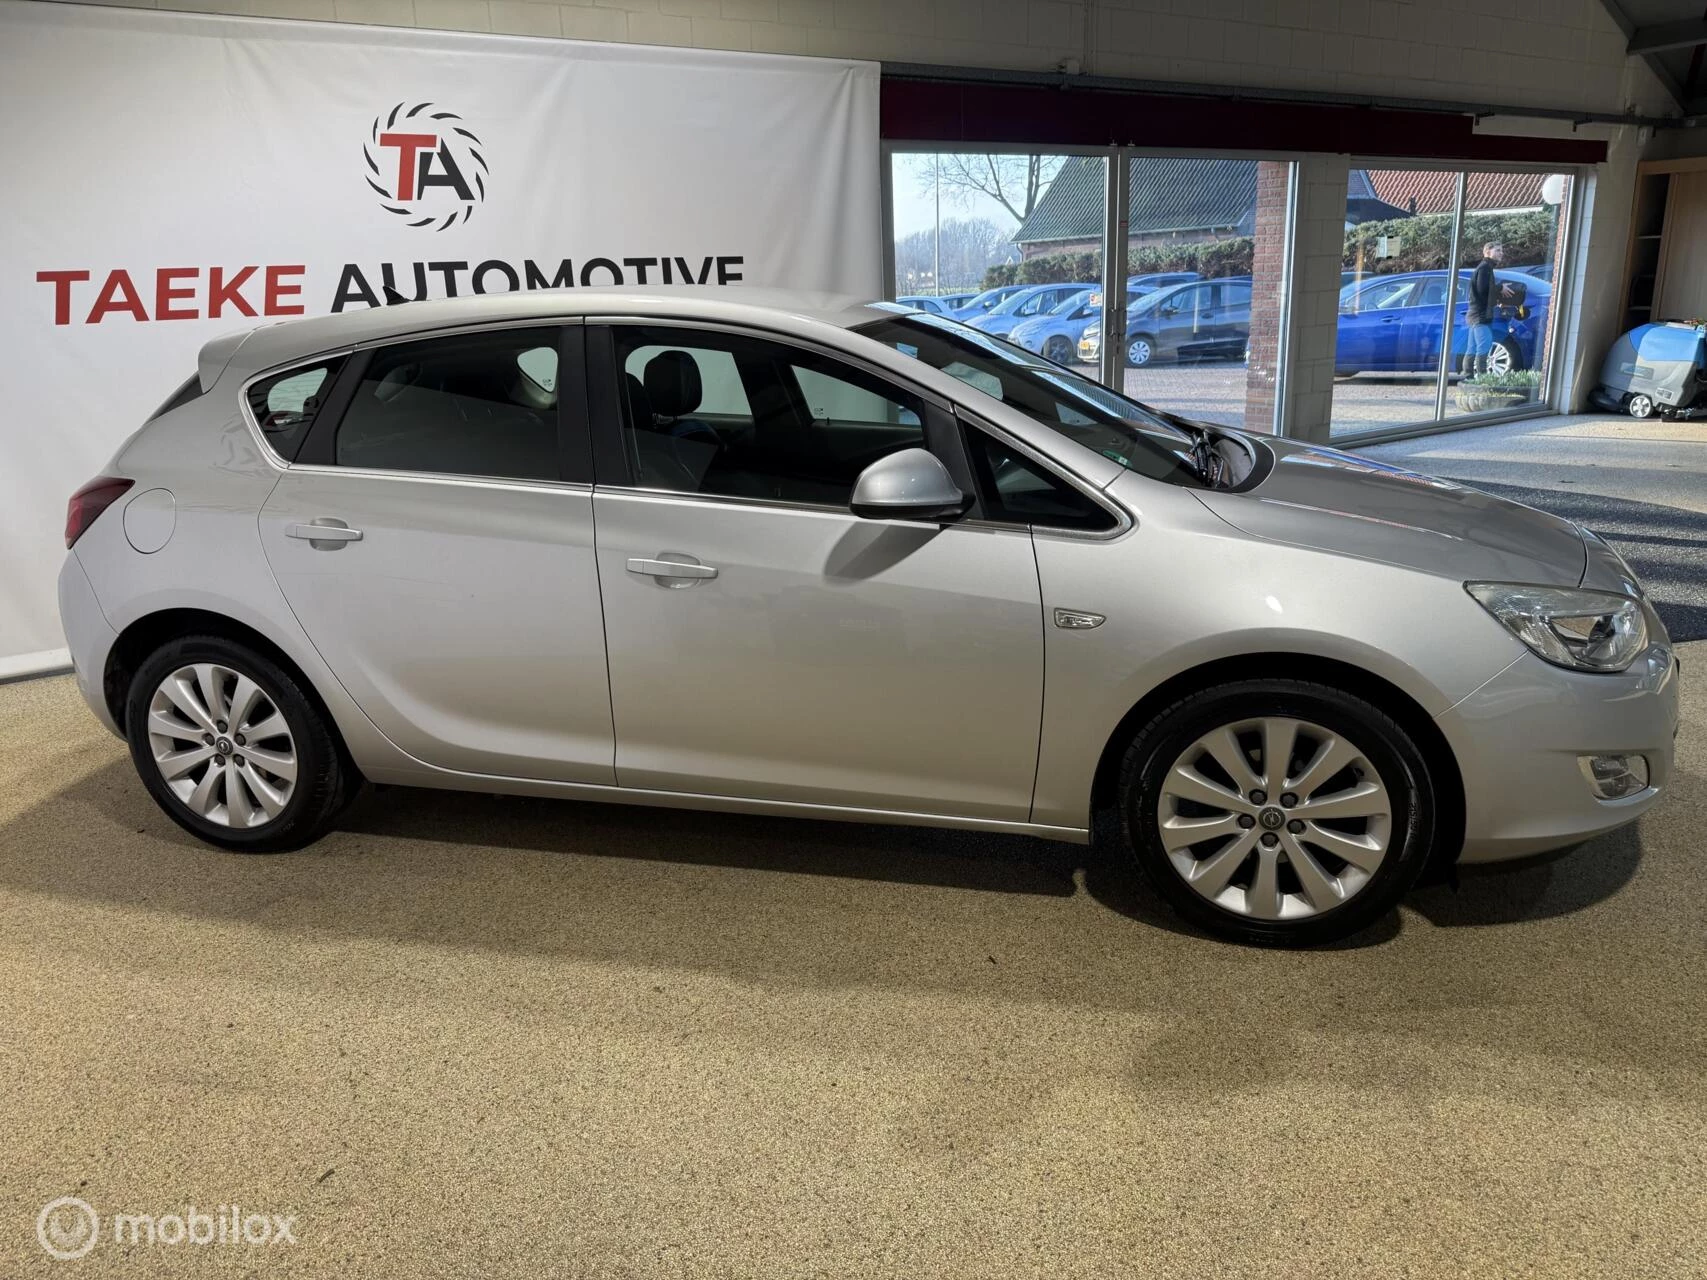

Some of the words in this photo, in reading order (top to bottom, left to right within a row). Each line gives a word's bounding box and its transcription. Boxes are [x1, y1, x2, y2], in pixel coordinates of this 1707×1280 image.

[379, 133, 476, 201] TA
[36, 264, 306, 326] TAEKE
[330, 256, 744, 313] AUTOMOTIVE
